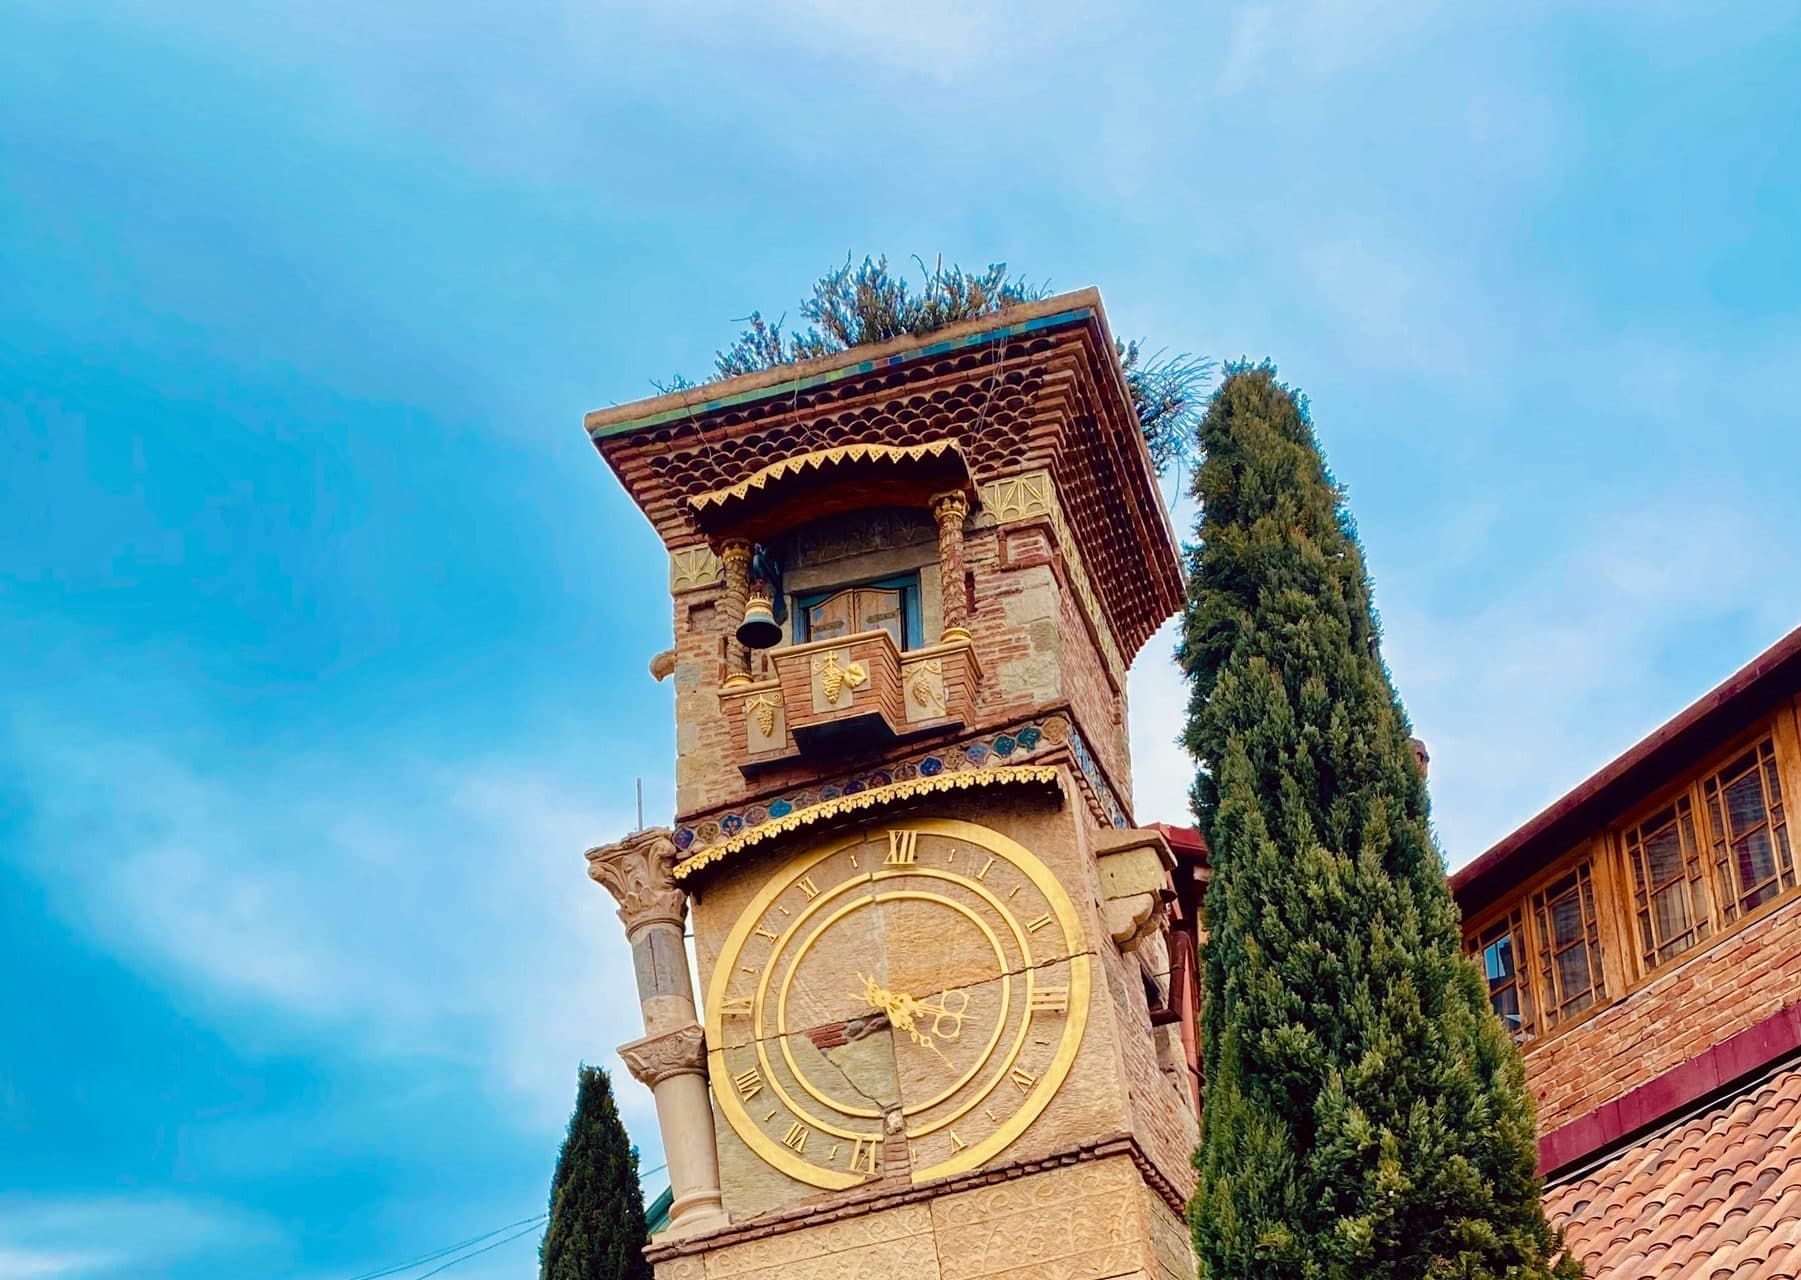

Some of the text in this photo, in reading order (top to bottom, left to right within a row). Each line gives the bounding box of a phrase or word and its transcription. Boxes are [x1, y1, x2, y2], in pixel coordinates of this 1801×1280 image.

[883, 829, 918, 865] XII
[976, 856, 996, 881] I
[796, 875, 822, 902] XI
[755, 925, 780, 944] X
[1025, 911, 1053, 935] II
[720, 996, 754, 1015] IX
[1031, 983, 1070, 1012] III
[733, 1065, 764, 1102] VIII
[1011, 1066, 1038, 1095] IV
[782, 1119, 810, 1154] VII
[950, 1129, 969, 1154] V
[849, 1135, 878, 1176] VI
